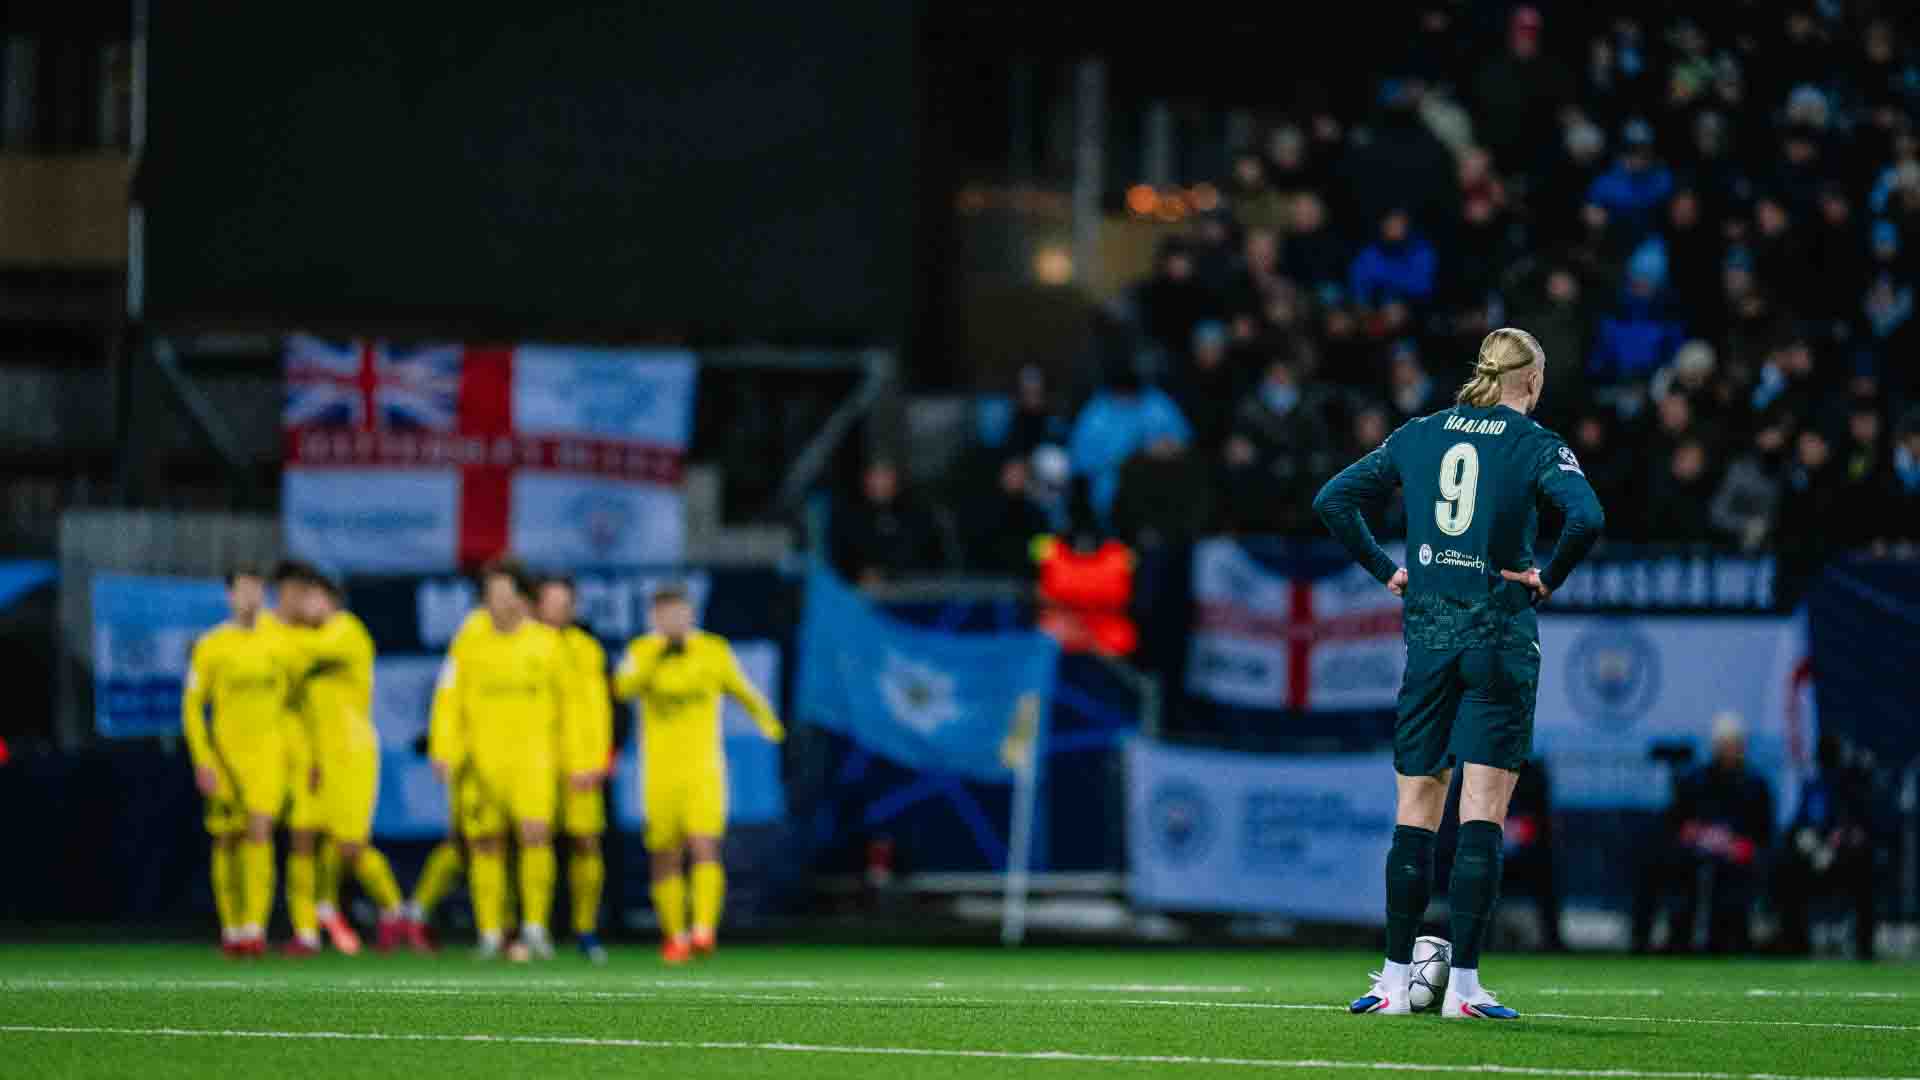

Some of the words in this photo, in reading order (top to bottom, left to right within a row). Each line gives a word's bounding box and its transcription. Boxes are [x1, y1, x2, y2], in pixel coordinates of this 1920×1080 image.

[1443, 415, 1507, 435] HAALAND
[1435, 442, 1479, 536] 9
[1435, 552, 1485, 575] Community
[1445, 549, 1461, 559] City
